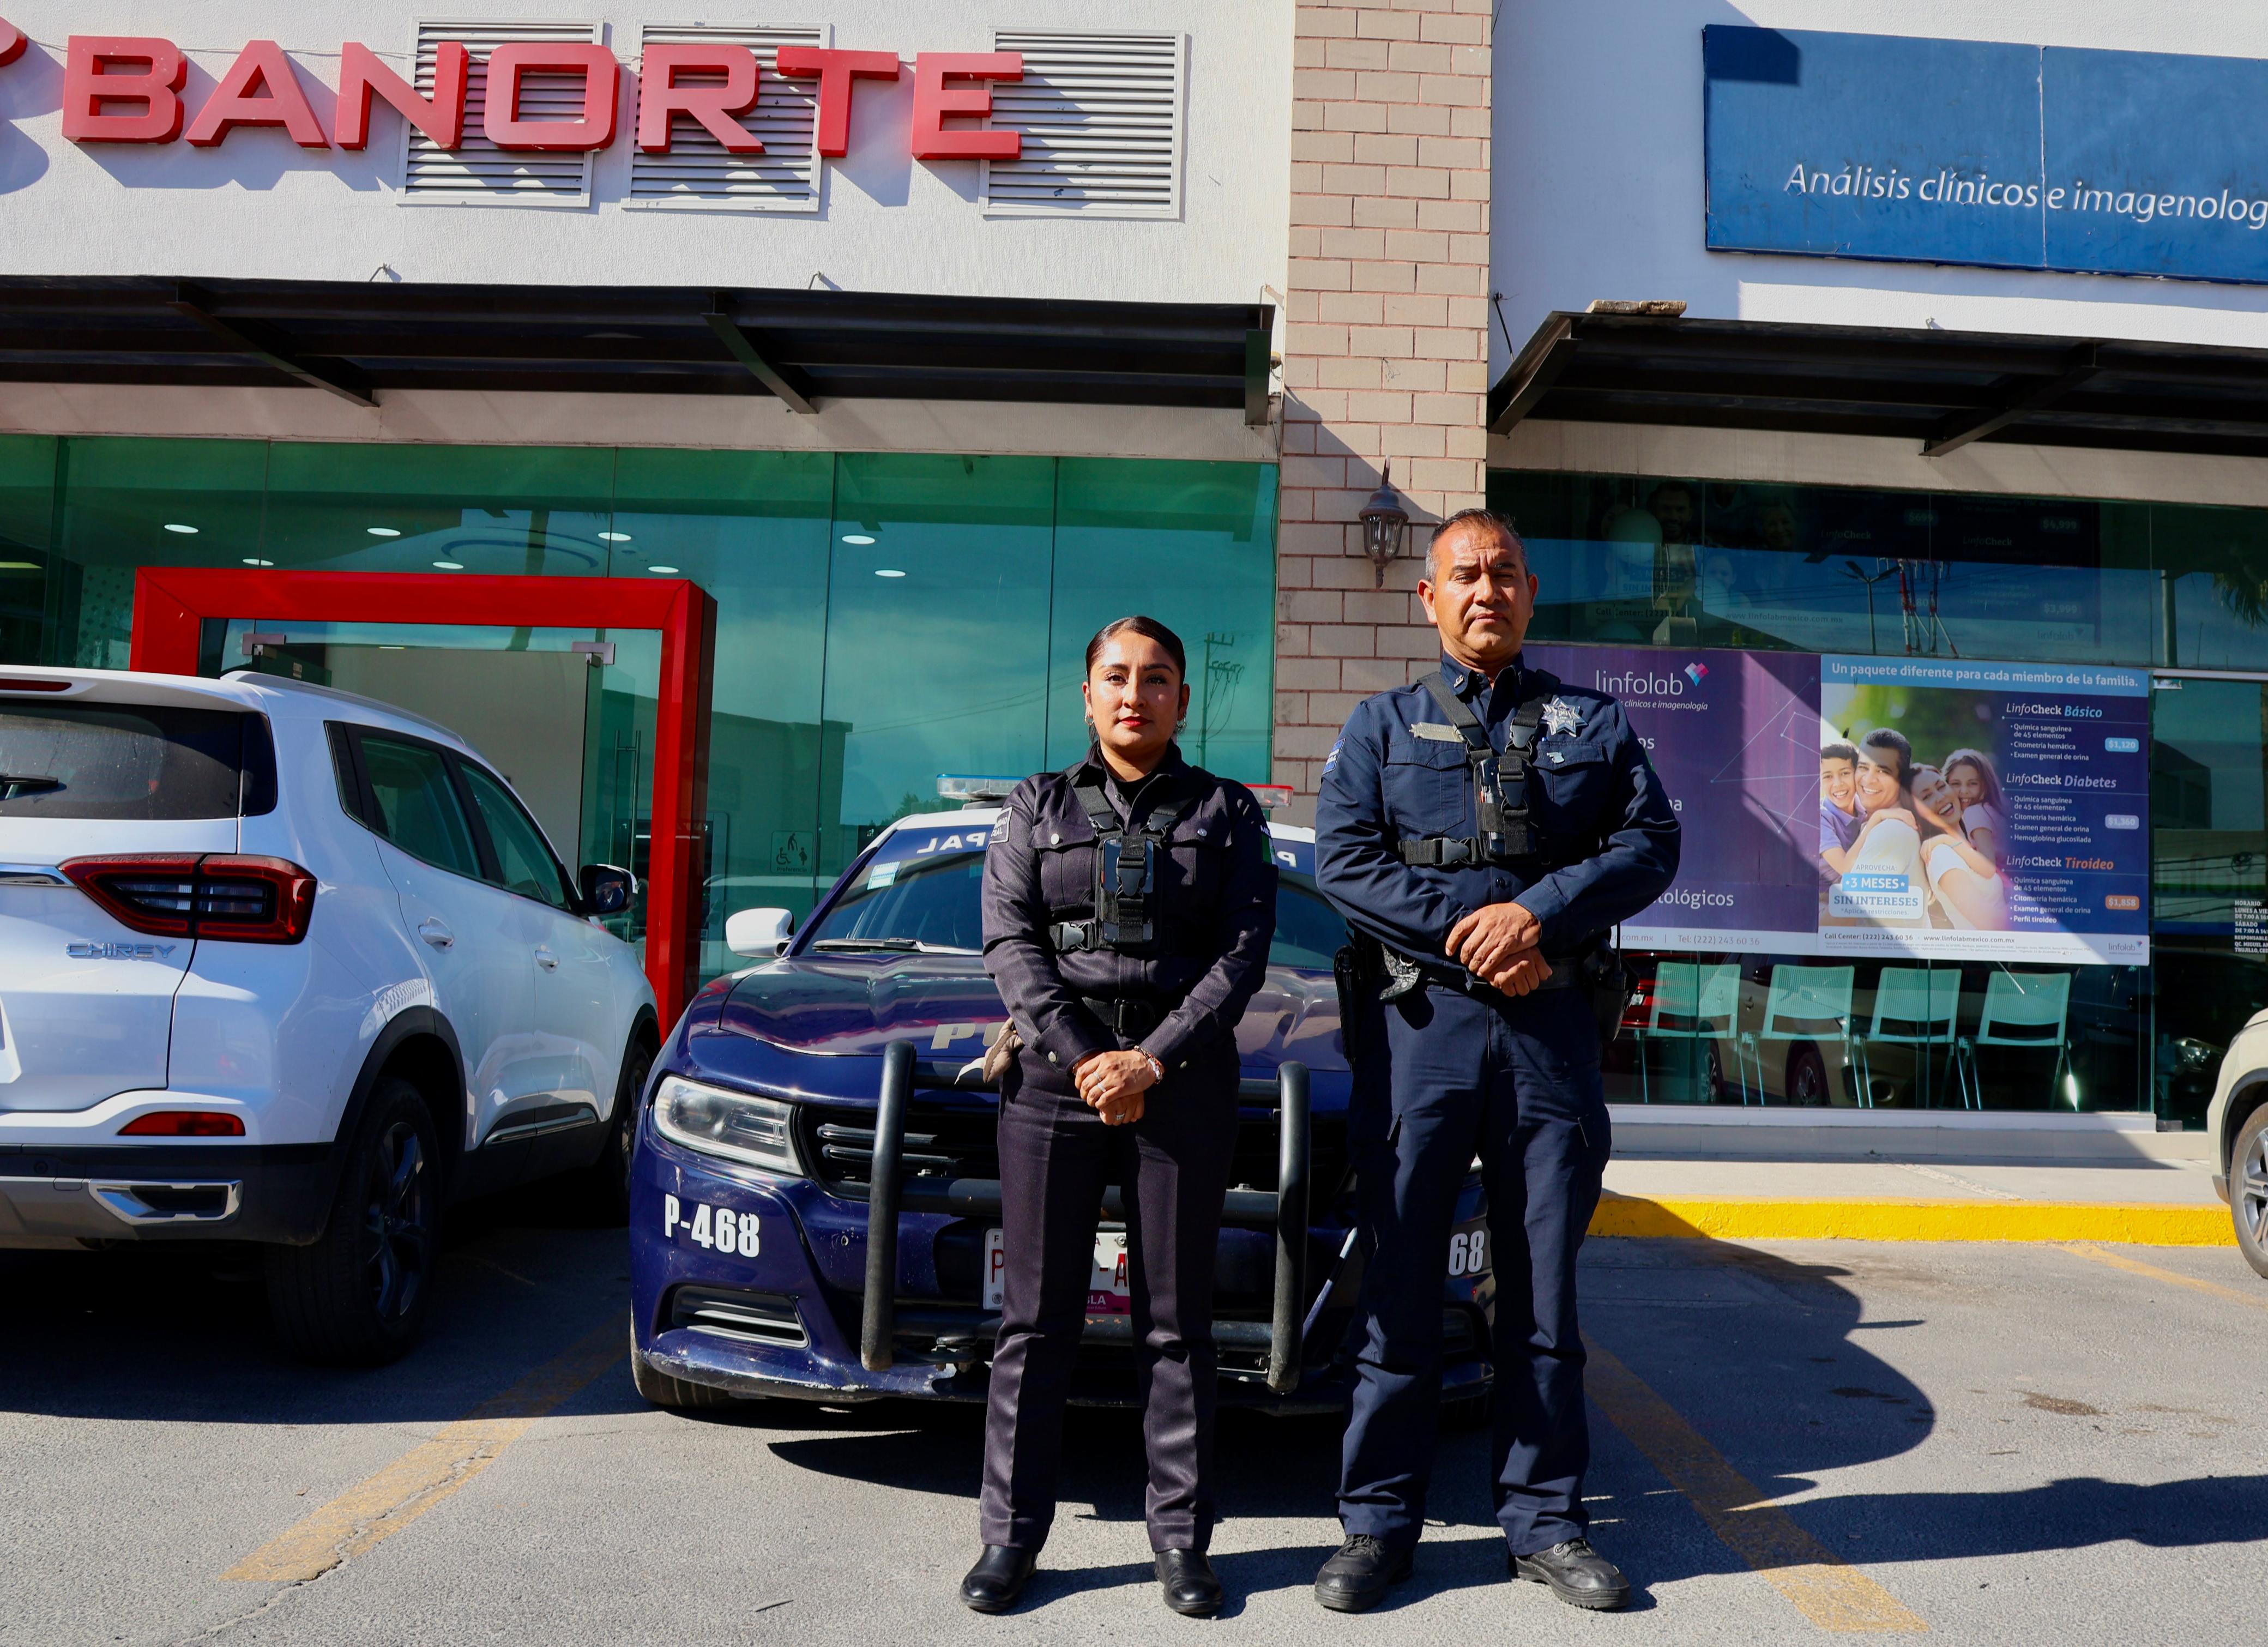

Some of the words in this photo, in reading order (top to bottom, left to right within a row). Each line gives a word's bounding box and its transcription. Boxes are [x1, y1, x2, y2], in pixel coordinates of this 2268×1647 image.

[62, 35, 1025, 160] BANORTE
[1783, 164, 1910, 199] Análisis
[1918, 166, 2038, 207] clínicos
[2047, 186, 2066, 210] e
[1832, 662, 1848, 674] Un
[1850, 665, 1897, 678] paquete
[1900, 665, 1953, 678] diferente
[1956, 671, 1981, 681] para
[1984, 670, 2010, 681] cada
[2012, 671, 2064, 684] miembro
[2066, 673, 2080, 684] de
[2083, 674, 2093, 685] la
[2095, 674, 2138, 687] familia.
[1596, 670, 1684, 695] linfolab
[1625, 698, 1651, 708] clínicos
[1658, 699, 1708, 711] imagenología
[2006, 703, 2062, 716] LinfoCheck
[2064, 705, 2103, 717] Básico
[2014, 741, 2046, 749] Citometría
[2039, 752, 2062, 761] general
[2006, 773, 2062, 786] LinfoCheck
[2064, 775, 2116, 788] Diabetes
[2040, 825, 2063, 833] general
[2014, 835, 2055, 843] Hemoglobina
[2056, 835, 2091, 843] glucosilada
[2006, 855, 2062, 868] LinfoCheck
[2065, 857, 2114, 870] Tiroideo
[1850, 877, 1858, 888] 3
[1861, 877, 1899, 889] MESES
[1833, 895, 1853, 905] SIN
[1856, 896, 1919, 907] INTERESES
[2014, 894, 2047, 902] Citometría
[2040, 906, 2064, 914] general
[1694, 934, 1716, 945] (222)
[1719, 936, 1734, 944] 243
[1736, 937, 1747, 945] 60
[1750, 937, 1760, 946] 36
[1862, 933, 1880, 941] (222)
[1923, 934, 2015, 943] www.linfolabmexico.com.mx
[65, 942, 177, 958] CHIREY
[665, 1193, 759, 1258] P-468
[1448, 1230, 1485, 1275] 68
